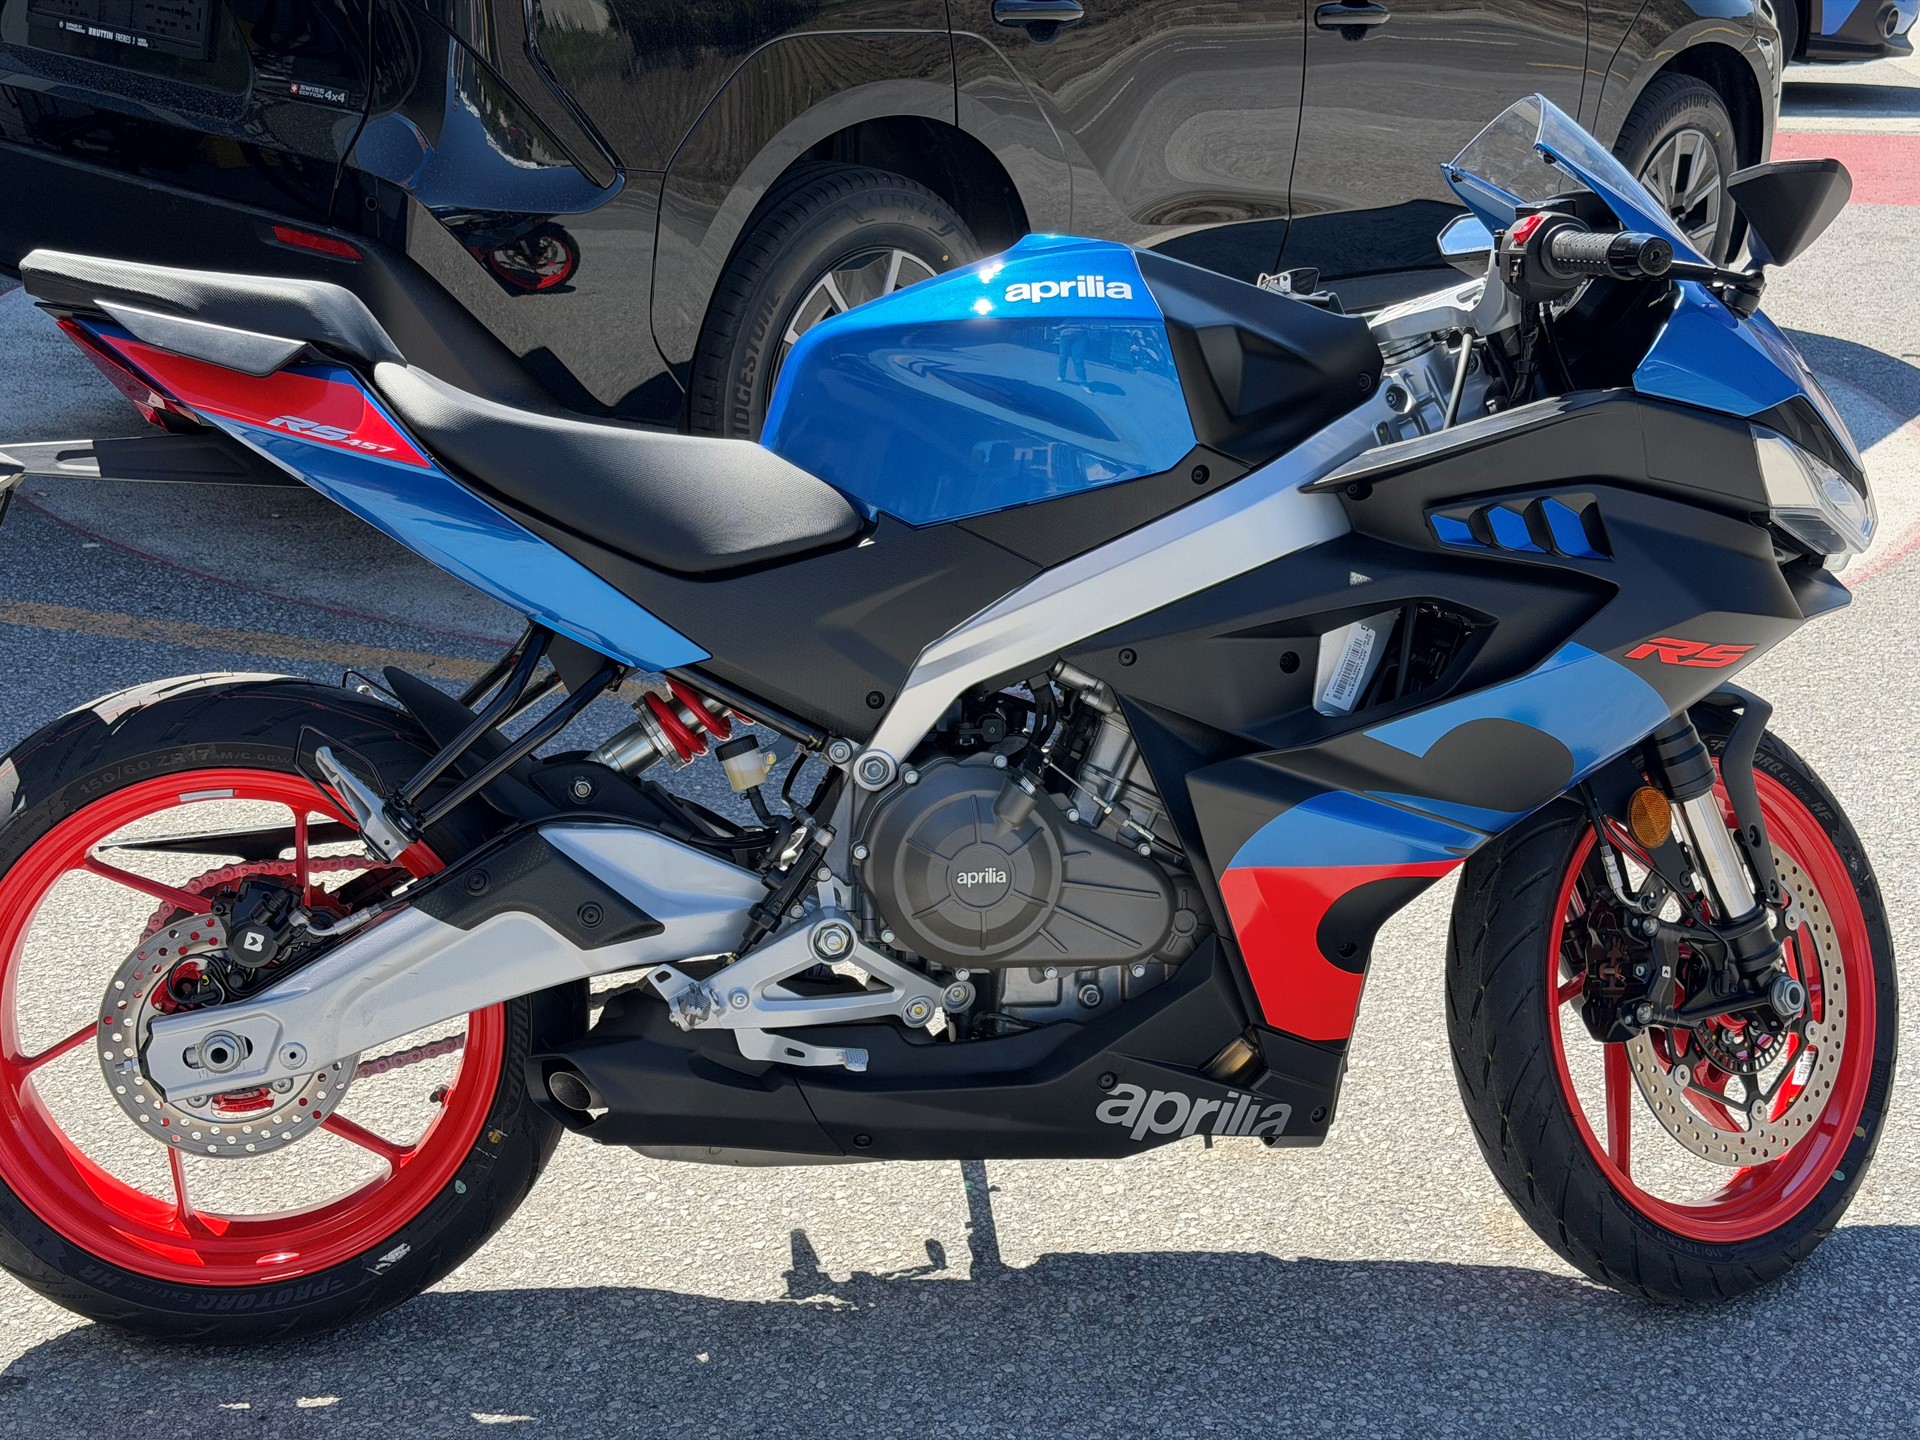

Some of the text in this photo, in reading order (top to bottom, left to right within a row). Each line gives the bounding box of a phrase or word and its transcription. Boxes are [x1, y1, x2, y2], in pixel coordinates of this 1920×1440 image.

[88, 27, 114, 40] BRUTTIN
[298, 90, 324, 99] EDITION
[300, 84, 325, 94] SWISS
[324, 90, 346, 103] 4x4
[1646, 92, 1710, 147] BRIDGESTONE
[866, 193, 940, 222] ALENZA
[1004, 275, 1133, 303] aprilia
[733, 289, 782, 437] IDGESTONE
[266, 415, 397, 453] RS 457
[1624, 637, 1757, 668] RS
[80, 760, 151, 794] 150/60
[157, 748, 210, 768] ZR17
[220, 750, 251, 760] M/C
[1810, 801, 1833, 820] HF
[957, 867, 1007, 888] aprilia
[509, 996, 530, 1099] OGRIP
[1095, 1083, 1292, 1141] aprilia
[78, 1263, 122, 1288] HR
[126, 1280, 193, 1301] Extreme
